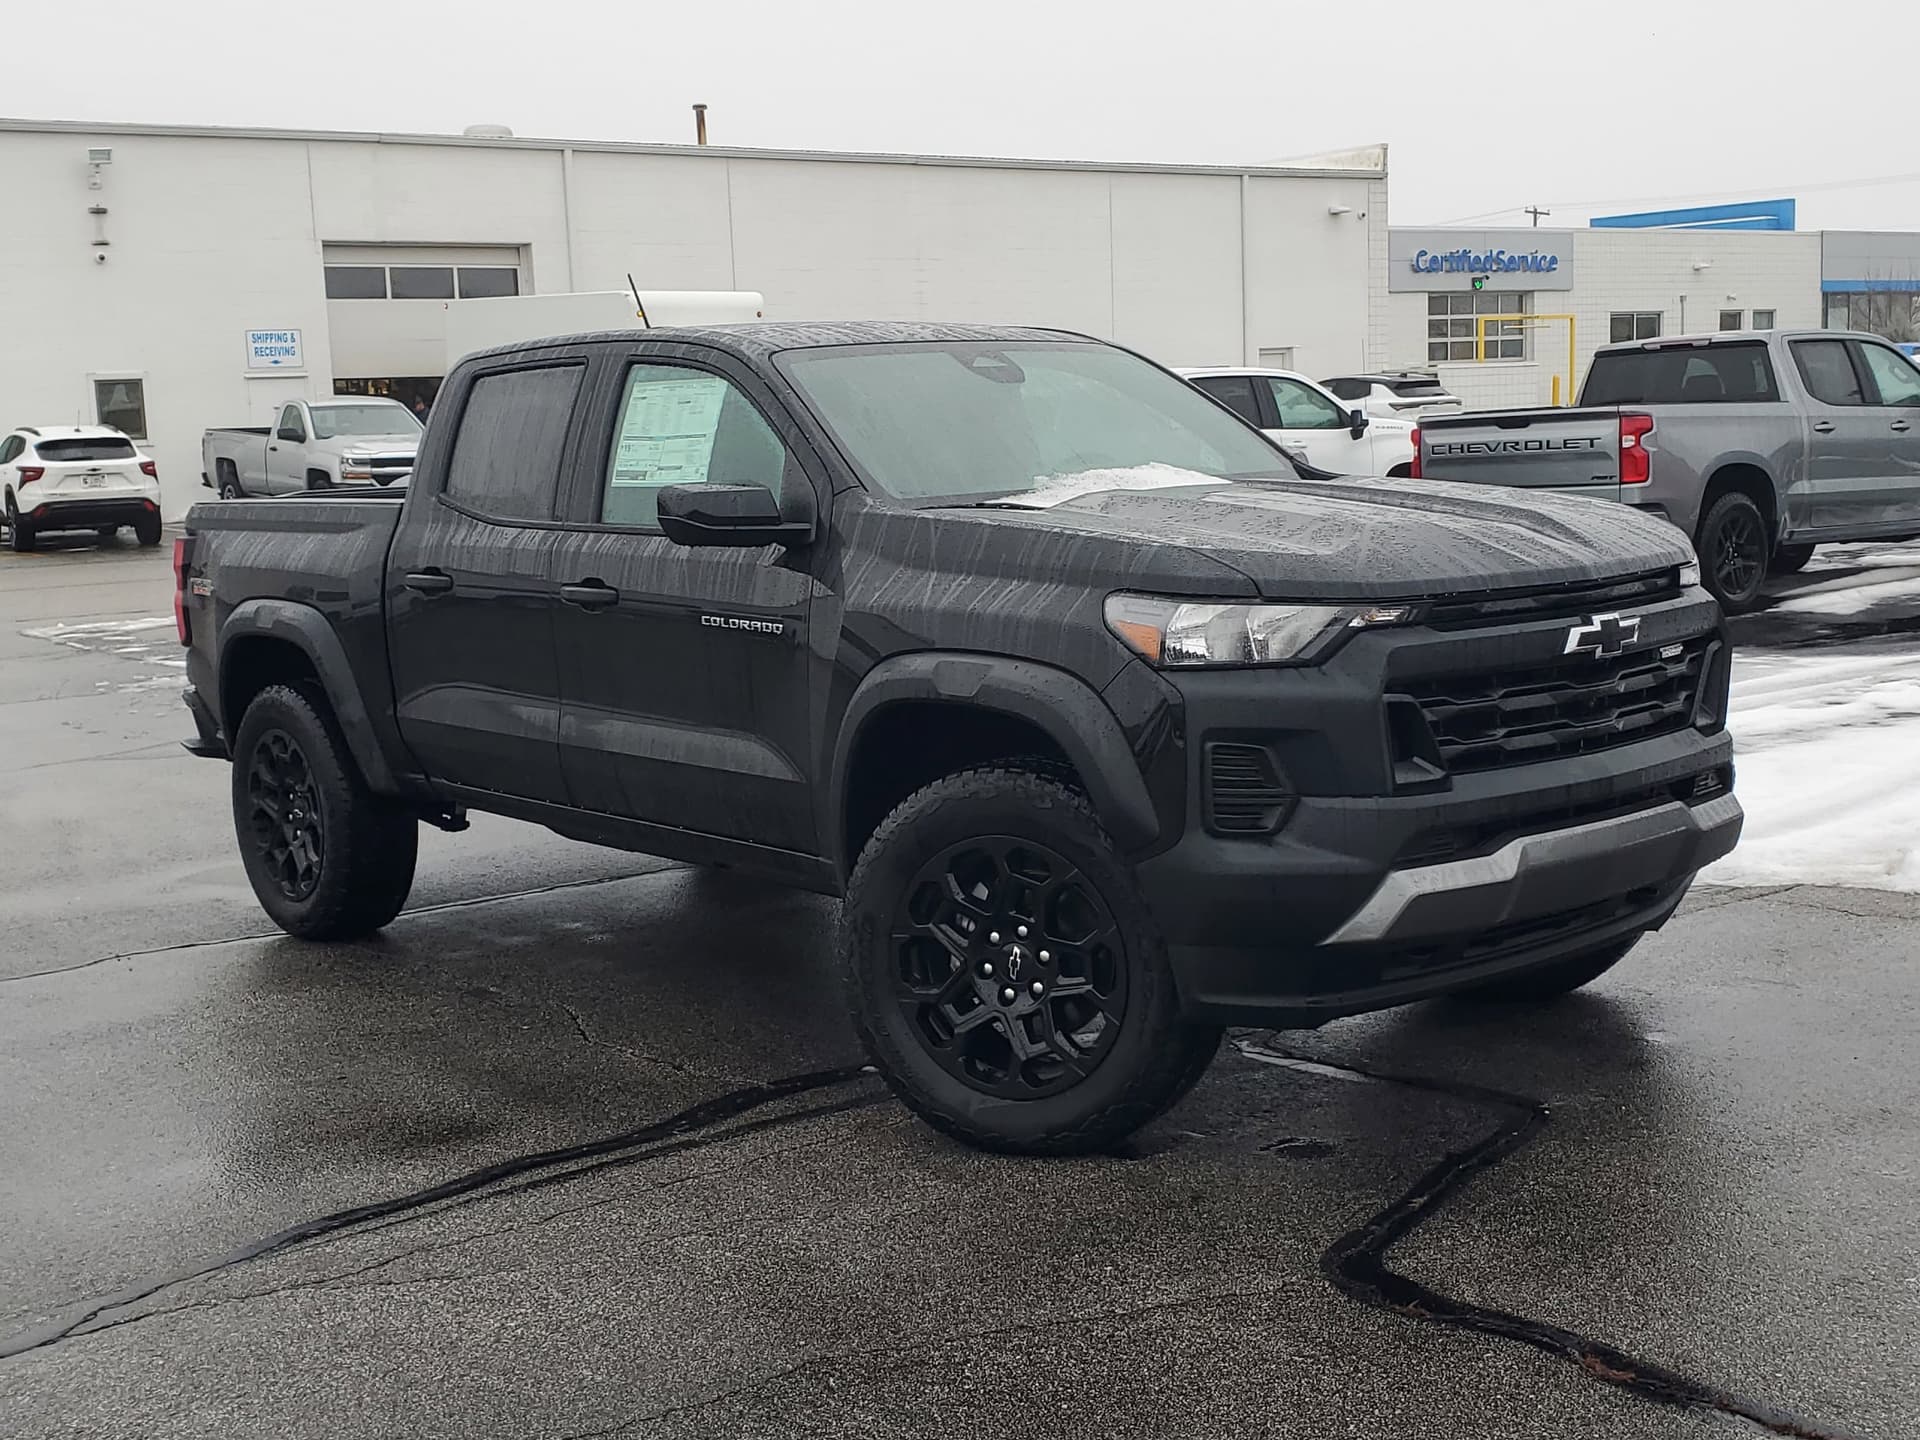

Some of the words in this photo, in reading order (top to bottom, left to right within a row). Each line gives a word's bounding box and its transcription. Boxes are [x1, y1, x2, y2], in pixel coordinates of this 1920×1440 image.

[251, 332, 288, 343] SHIPPING
[290, 332, 296, 343] &
[254, 346, 296, 357] RECEIVING
[1431, 437, 1602, 456] CHEVROLET
[701, 615, 784, 634] COLORADO
